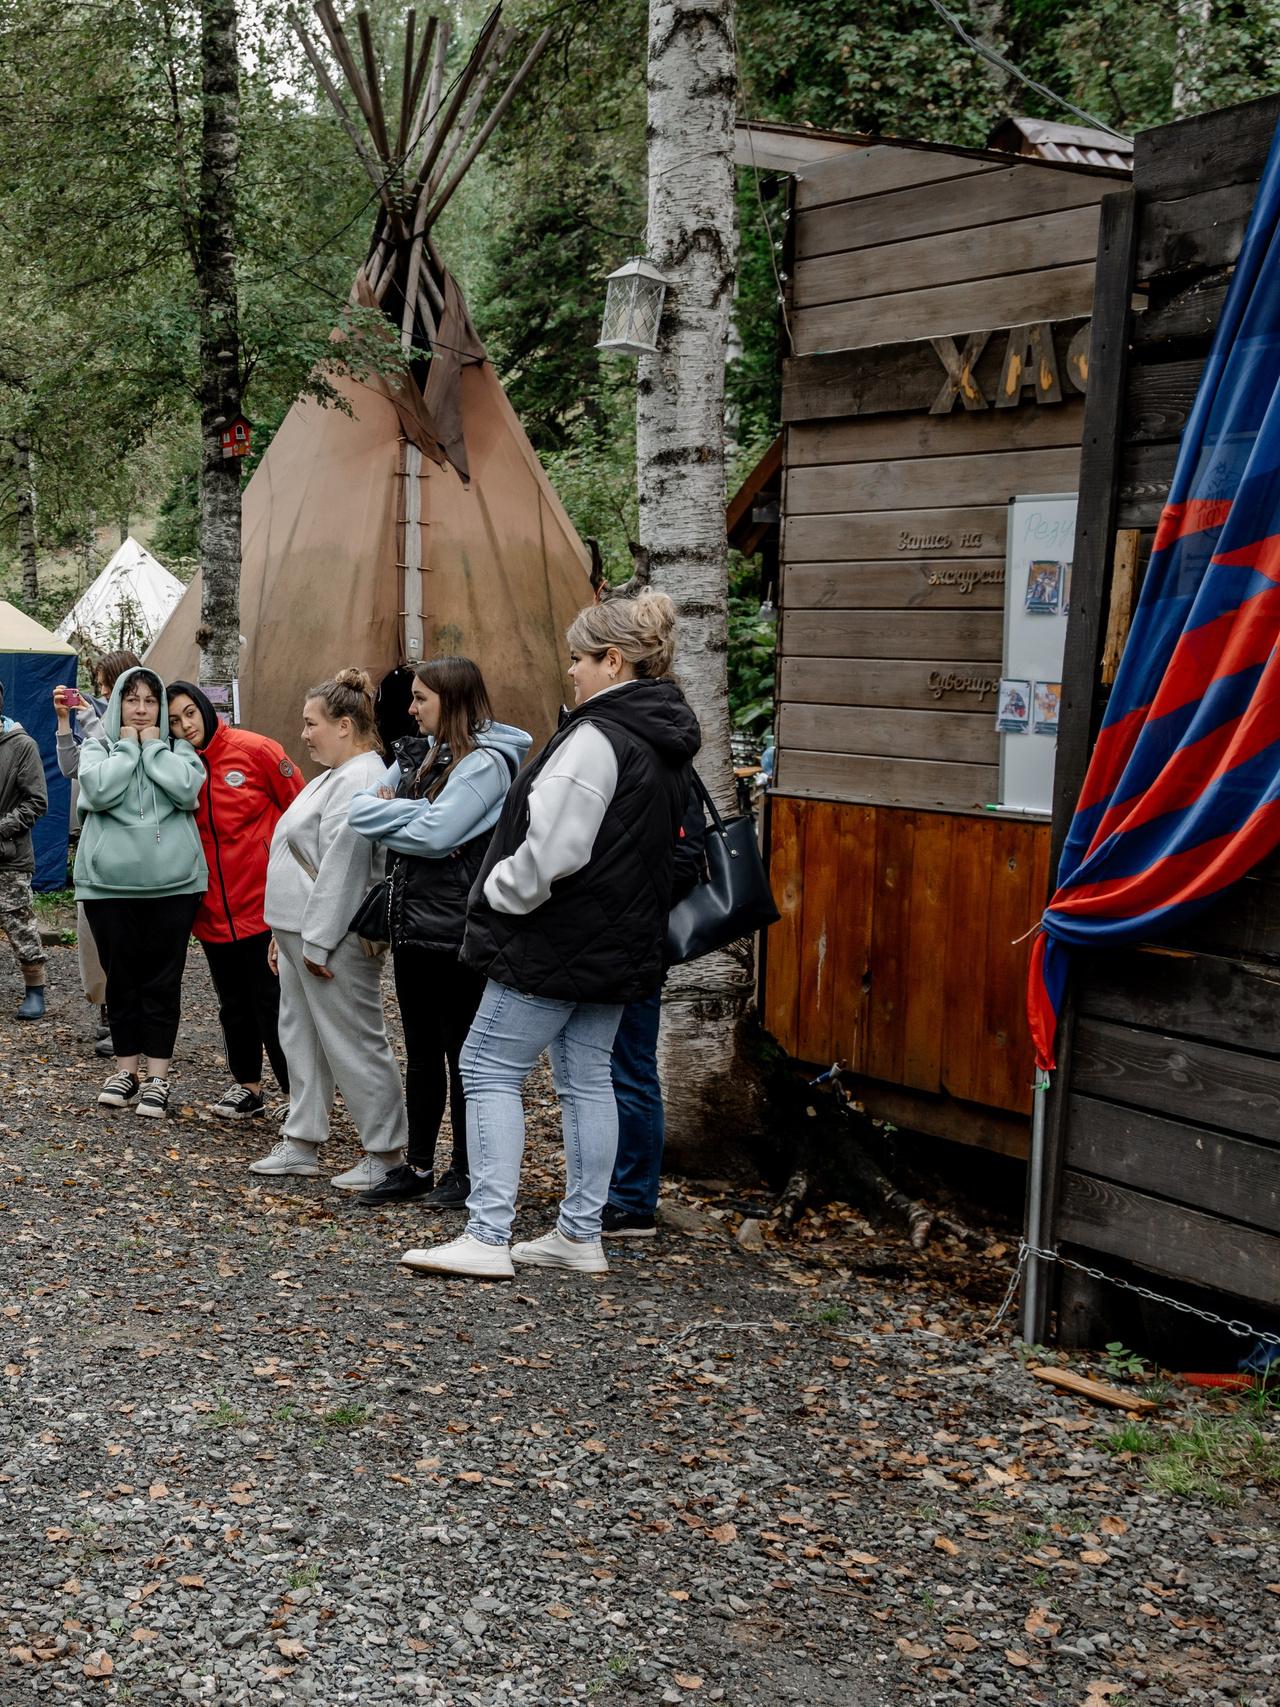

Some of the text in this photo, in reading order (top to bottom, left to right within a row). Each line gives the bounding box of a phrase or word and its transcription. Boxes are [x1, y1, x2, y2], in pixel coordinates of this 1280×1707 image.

[897, 531, 982, 550] Запись на
[1024, 512, 1076, 549] Резу
